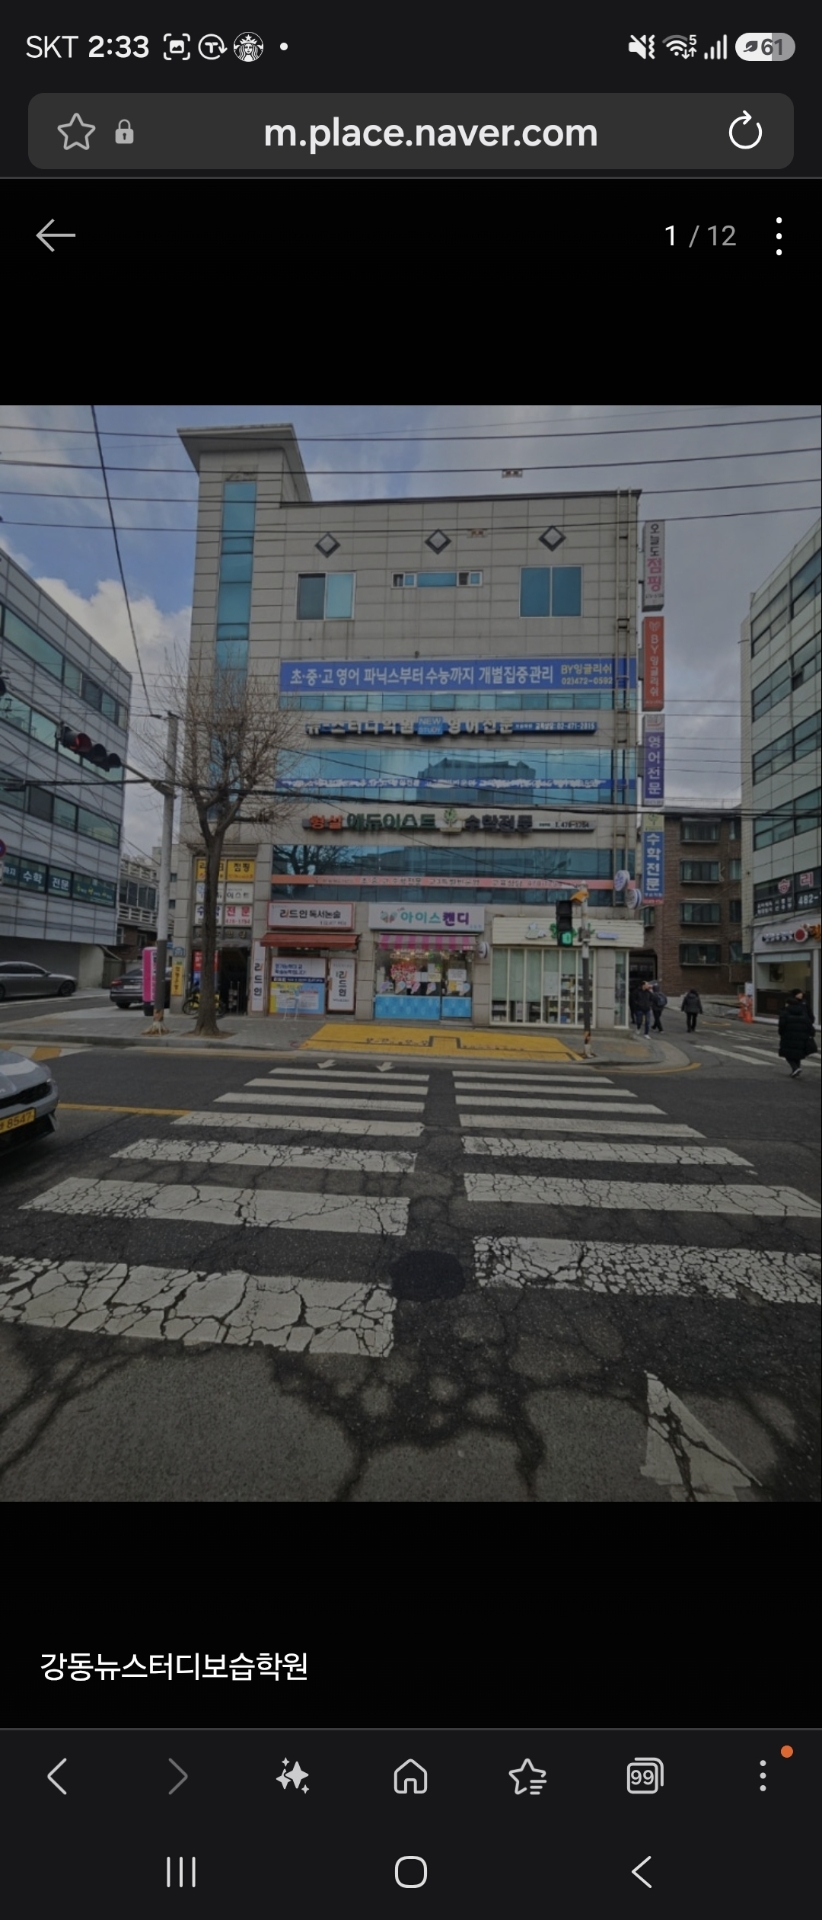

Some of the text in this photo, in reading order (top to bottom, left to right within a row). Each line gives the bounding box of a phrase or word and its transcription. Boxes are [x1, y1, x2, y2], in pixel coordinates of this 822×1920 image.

[26, 36, 149, 58] SKT 2:33
[761, 38, 783, 56] 61
[264, 116, 598, 155] m.place.naver.com
[665, 225, 675, 246] 1
[707, 225, 737, 246] 12
[649, 523, 660, 557] 오늘도
[647, 558, 662, 592] 점핑
[336, 667, 360, 686] 영어
[363, 667, 424, 686] 파닉스부터
[426, 666, 474, 685] 수능까지
[479, 665, 553, 685] 개별집중관리
[561, 664, 612, 675] BY잉글리쉬
[419, 717, 442, 725] NEW
[448, 716, 513, 735] 영어전문
[648, 736, 662, 795] 영어전문
[309, 813, 438, 832] 형설 에듀이스트
[464, 814, 533, 833] 수학전문
[646, 833, 662, 892] 수학전문
[23, 871, 43, 884] 수학
[52, 877, 70, 891] 전문
[279, 909, 342, 919] 리드인 독서논술
[254, 962, 264, 997] 리드인
[338, 970, 348, 997] 리드인
[41, 1652, 308, 1682] 강동뉴스터디보습학원
[630, 1769, 655, 1785] 99
